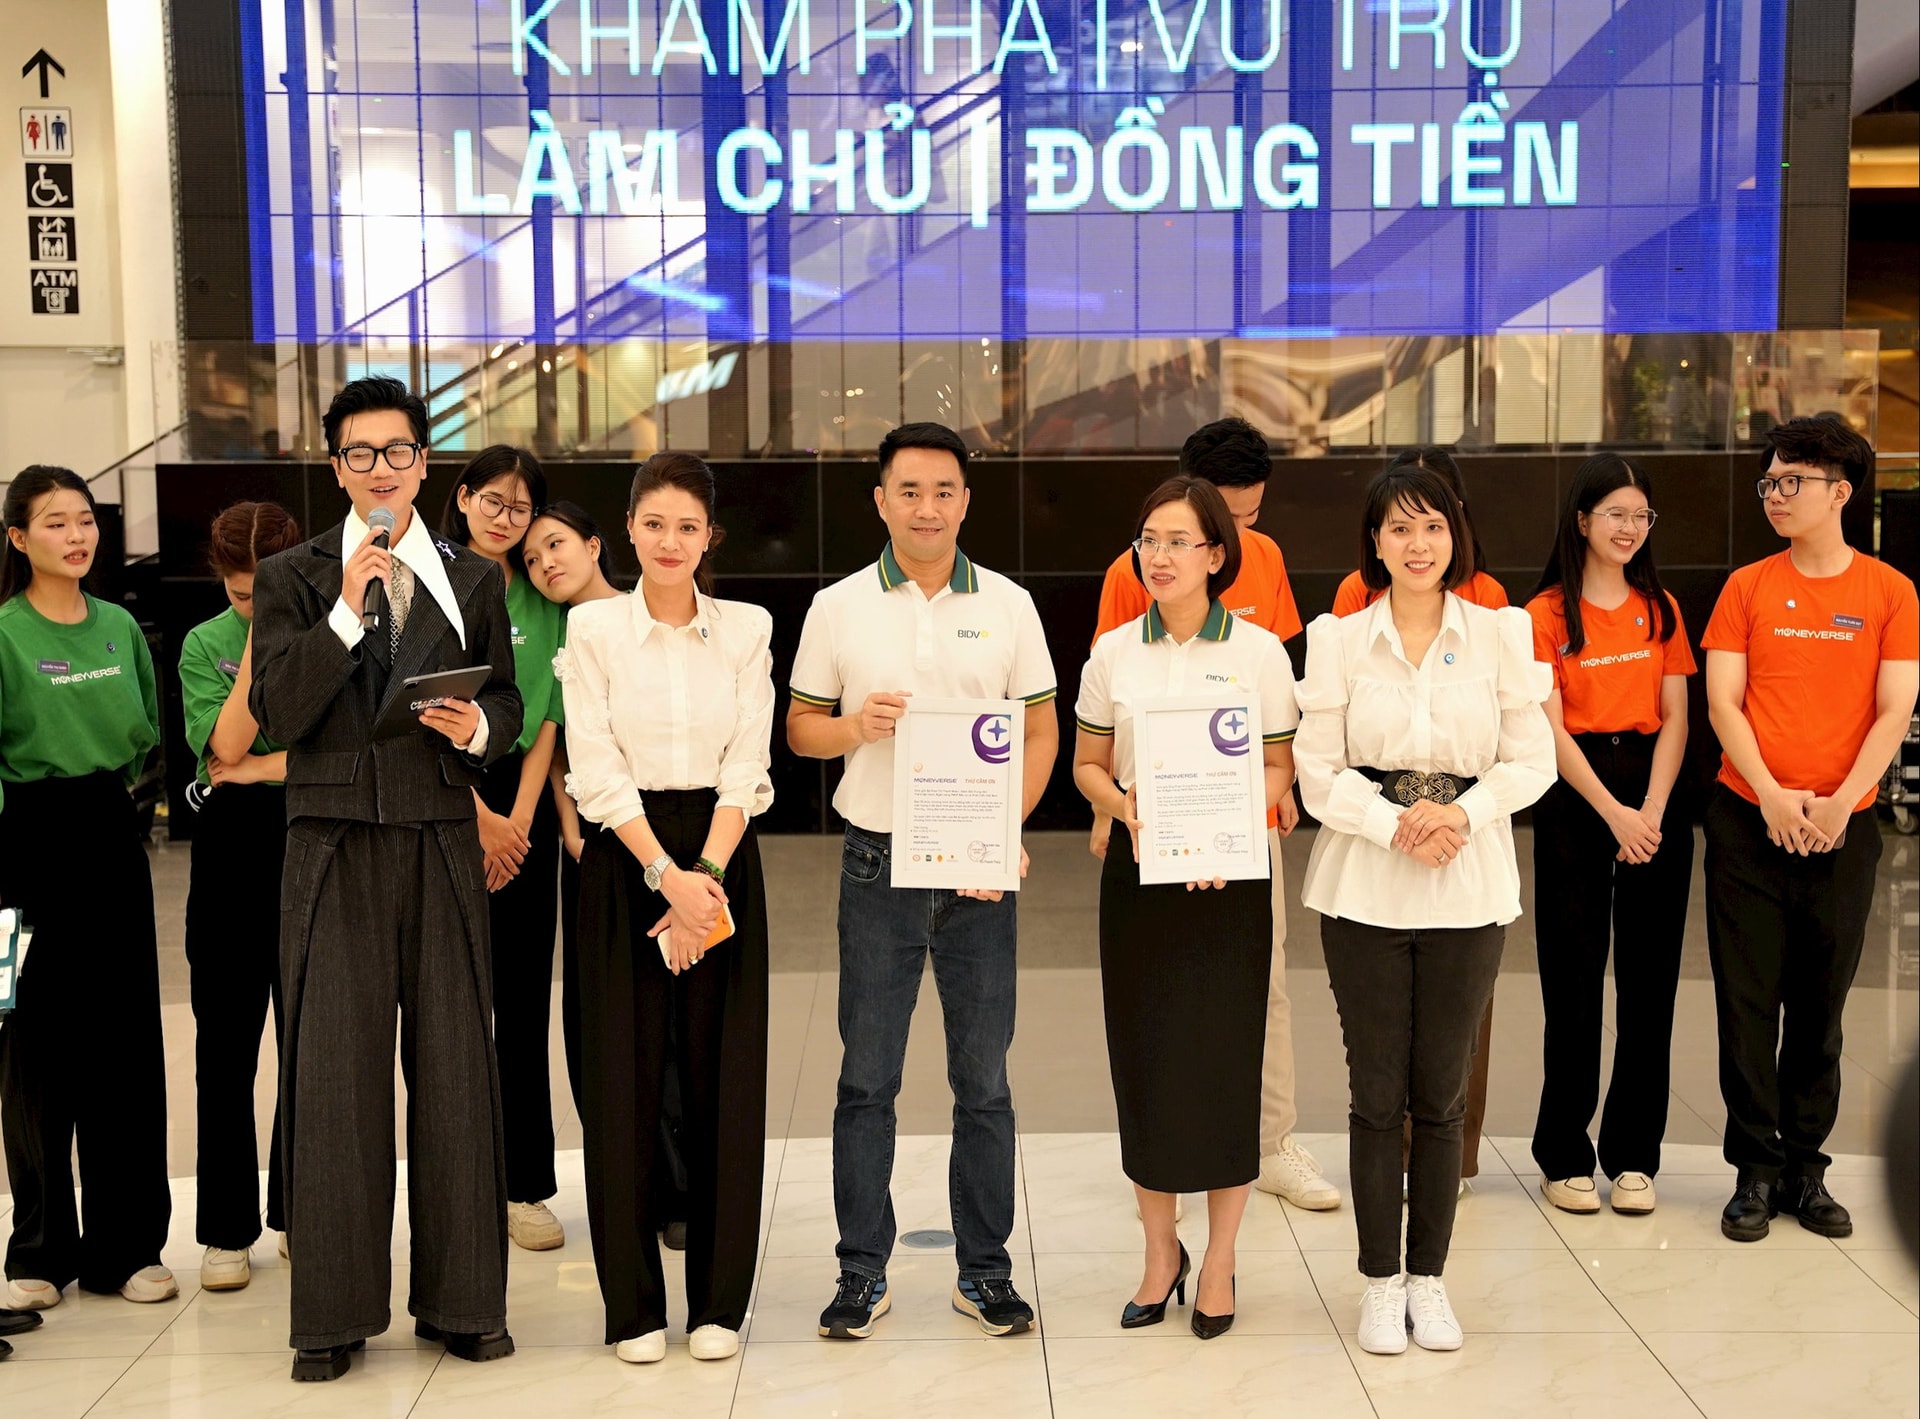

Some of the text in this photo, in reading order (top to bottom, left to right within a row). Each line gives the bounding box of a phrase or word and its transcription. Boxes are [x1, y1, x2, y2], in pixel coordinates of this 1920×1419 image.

[453, 108, 679, 215] LÀM
[716, 102, 932, 214] CHỦ
[1025, 96, 1320, 213] ĐỒNG
[1350, 91, 1579, 208] TIỀN
[33, 270, 77, 287] ATM
[957, 629, 981, 639] BIDV
[1774, 627, 1854, 641] MONEYVERSE
[1580, 649, 1652, 668] MONEYVERSE
[50, 666, 121, 685] MONEYVERSE
